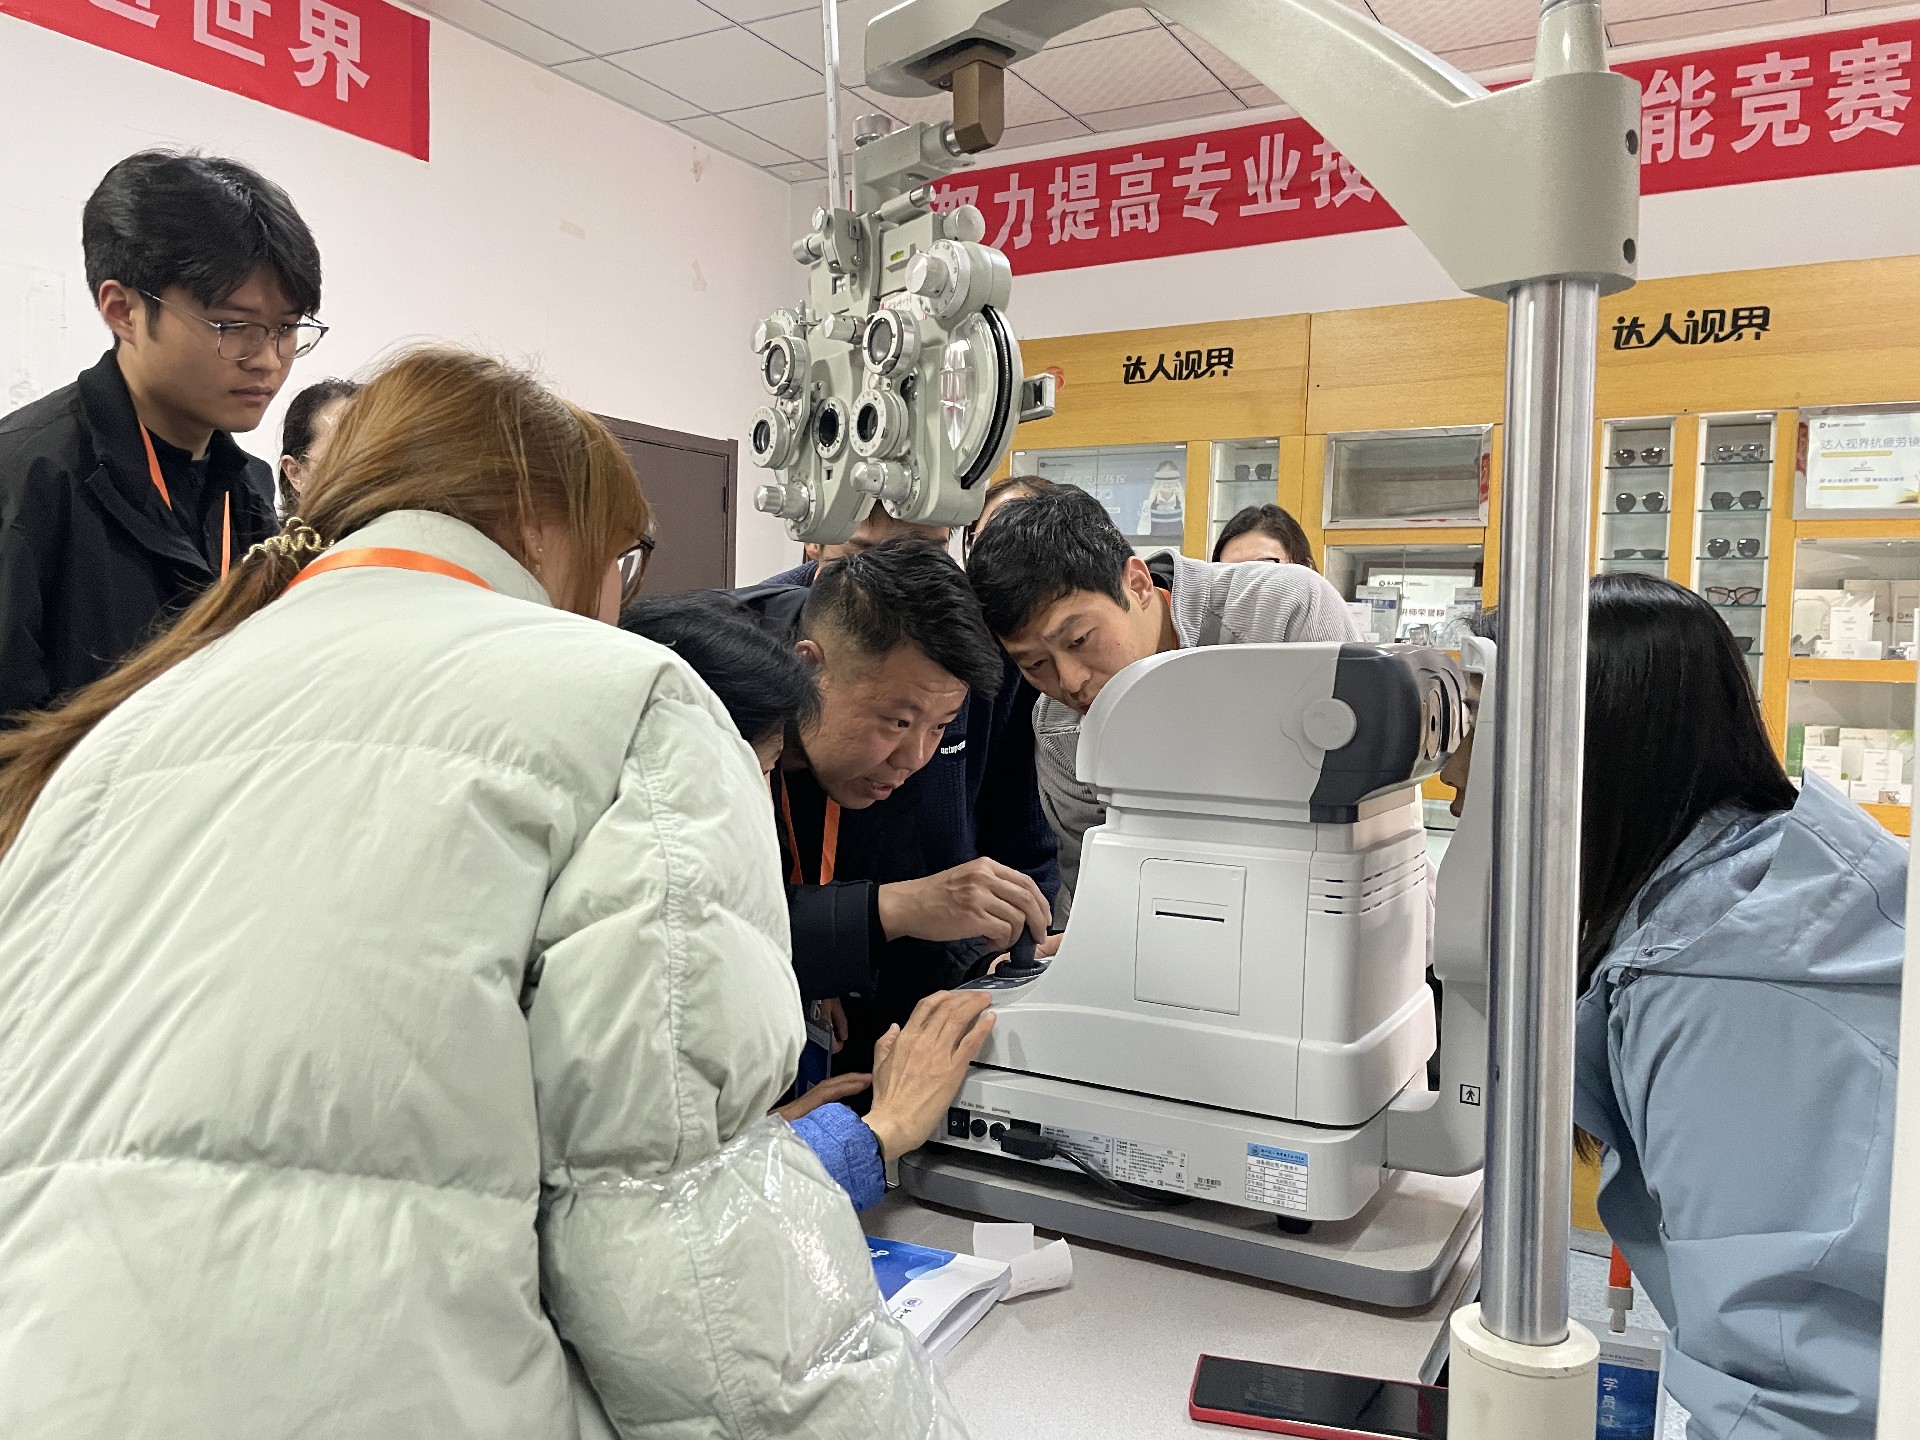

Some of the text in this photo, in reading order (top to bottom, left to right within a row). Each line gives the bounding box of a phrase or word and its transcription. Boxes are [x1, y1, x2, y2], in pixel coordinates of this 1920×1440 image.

[1641, 37, 1912, 164] 能竞赛
[1612, 306, 1770, 350] 达人视界
[1123, 347, 1234, 384] 达人视界
